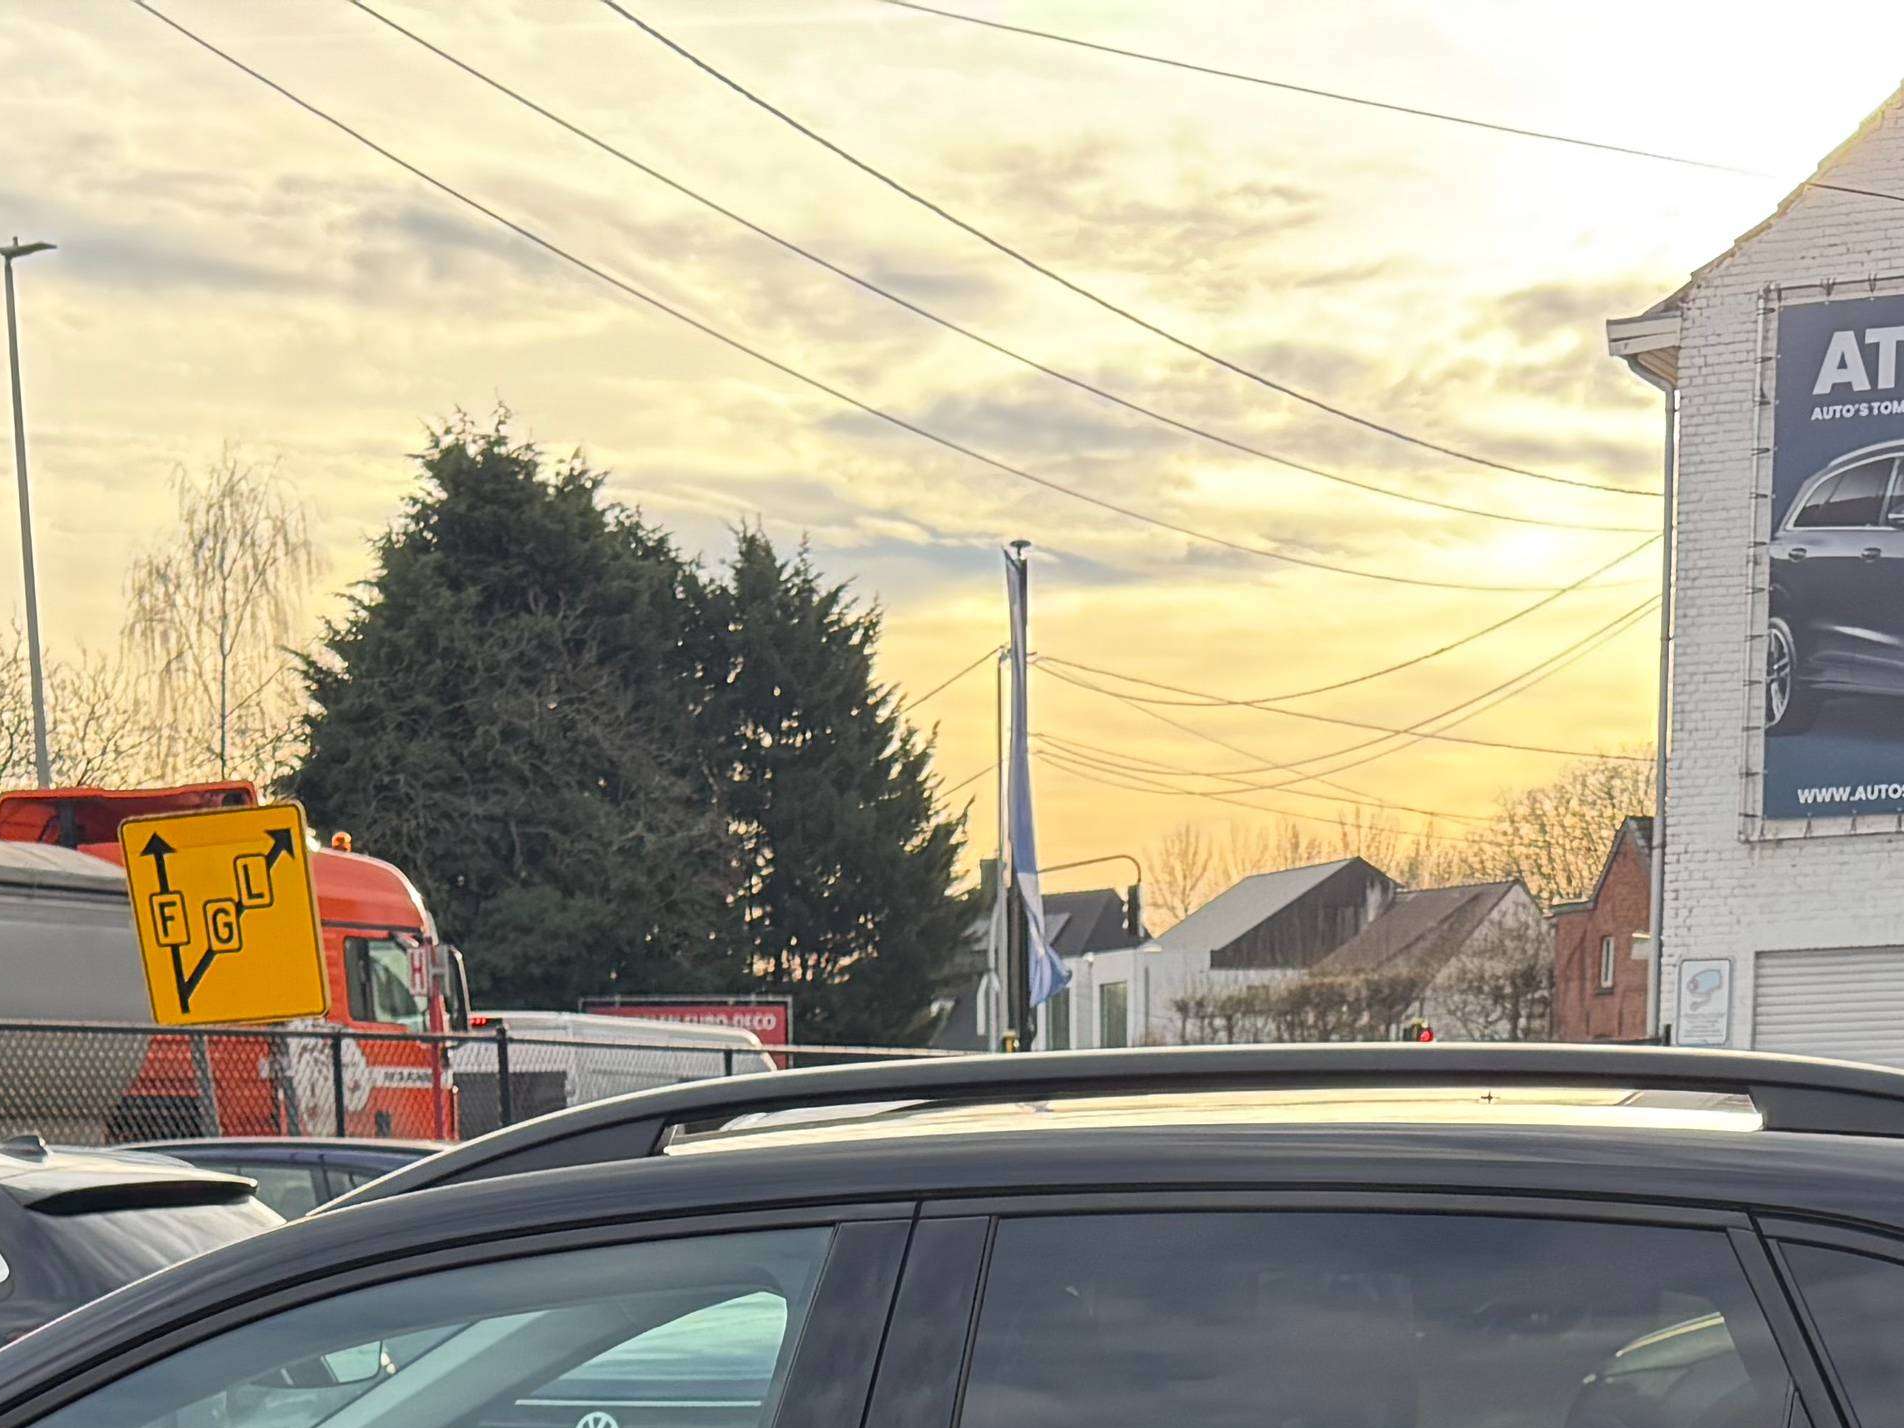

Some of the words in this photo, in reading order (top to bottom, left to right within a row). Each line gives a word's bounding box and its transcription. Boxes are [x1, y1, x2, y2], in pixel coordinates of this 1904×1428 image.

[1811, 401, 1869, 421] AUTO'S
[243, 864, 265, 900] L
[158, 901, 177, 938] F
[212, 908, 234, 944] G
